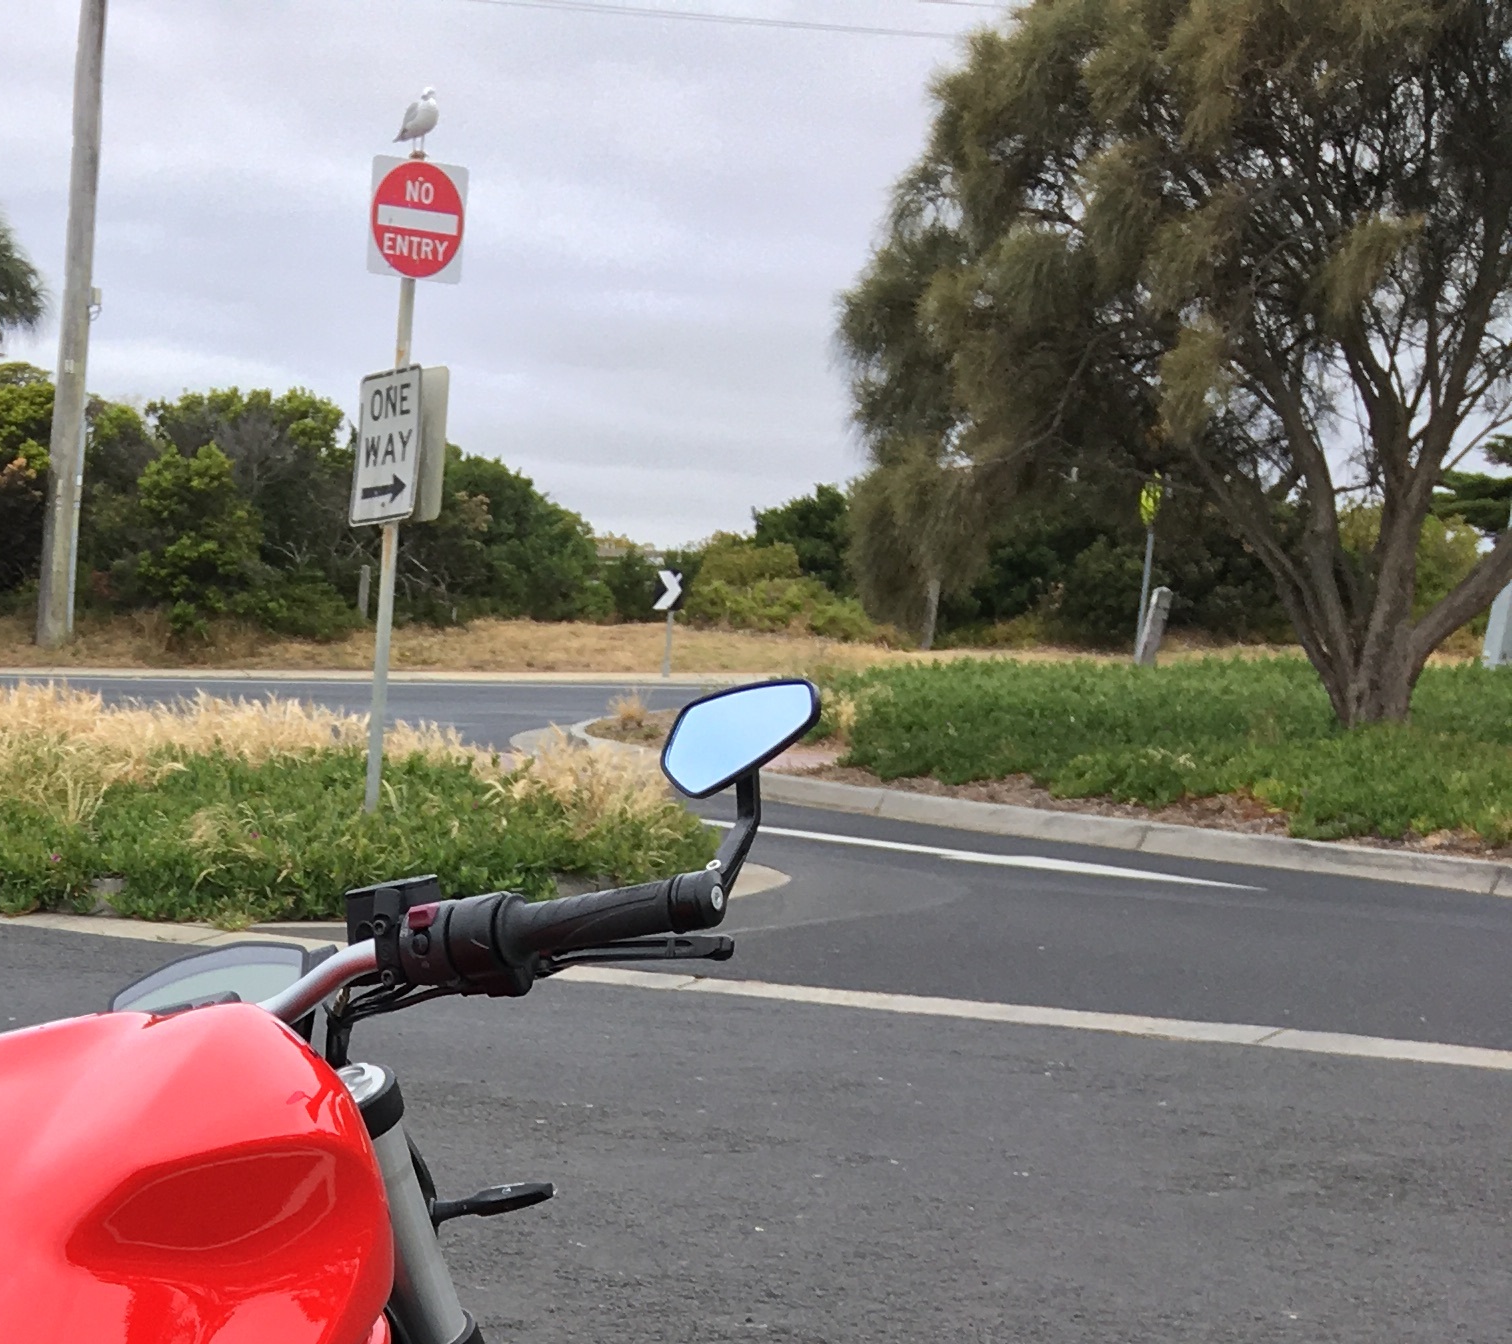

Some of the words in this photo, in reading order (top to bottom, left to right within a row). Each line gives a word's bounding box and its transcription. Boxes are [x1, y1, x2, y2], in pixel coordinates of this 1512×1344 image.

[406, 179, 435, 206] NO
[382, 232, 449, 263] ENTRY
[369, 382, 412, 422] ONE
[364, 428, 414, 468] WAY
